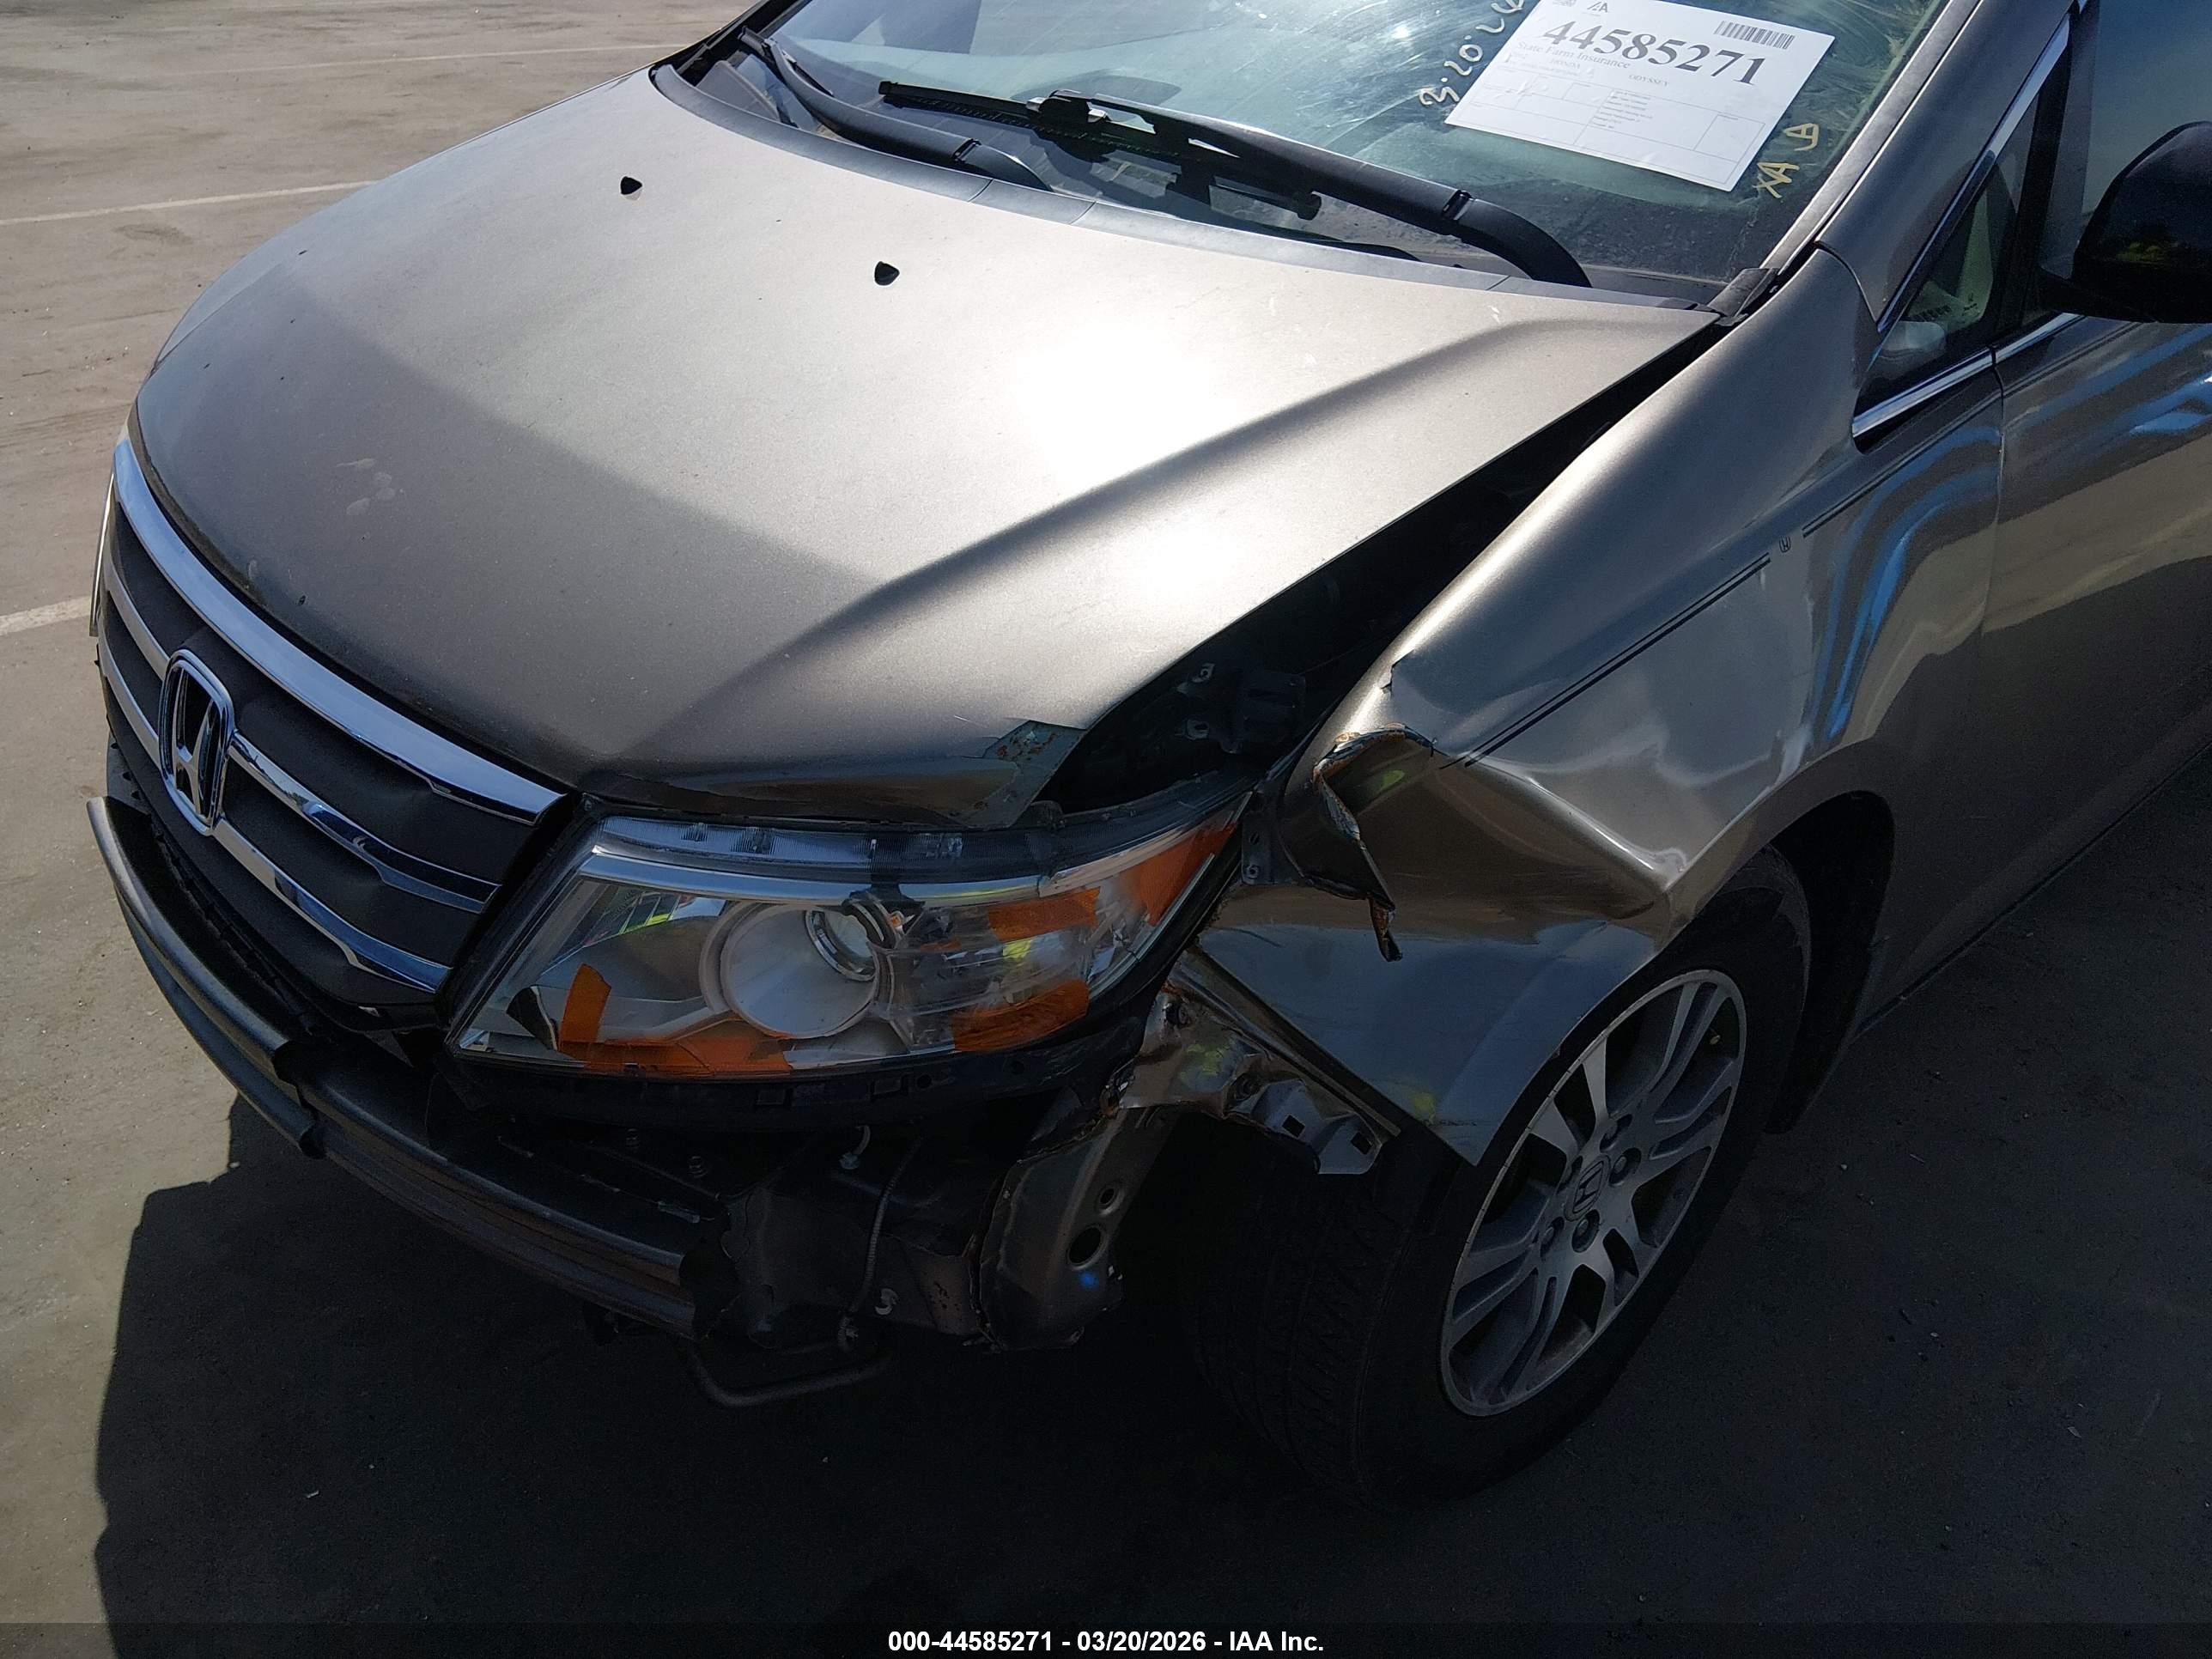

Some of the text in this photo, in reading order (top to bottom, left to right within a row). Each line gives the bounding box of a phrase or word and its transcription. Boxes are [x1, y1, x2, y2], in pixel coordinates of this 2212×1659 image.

[1517, 41, 1542, 53] State
[1545, 46, 1574, 58] Farm
[1577, 52, 1631, 69] Insurance
[1541, 21, 1765, 86] 44585271
